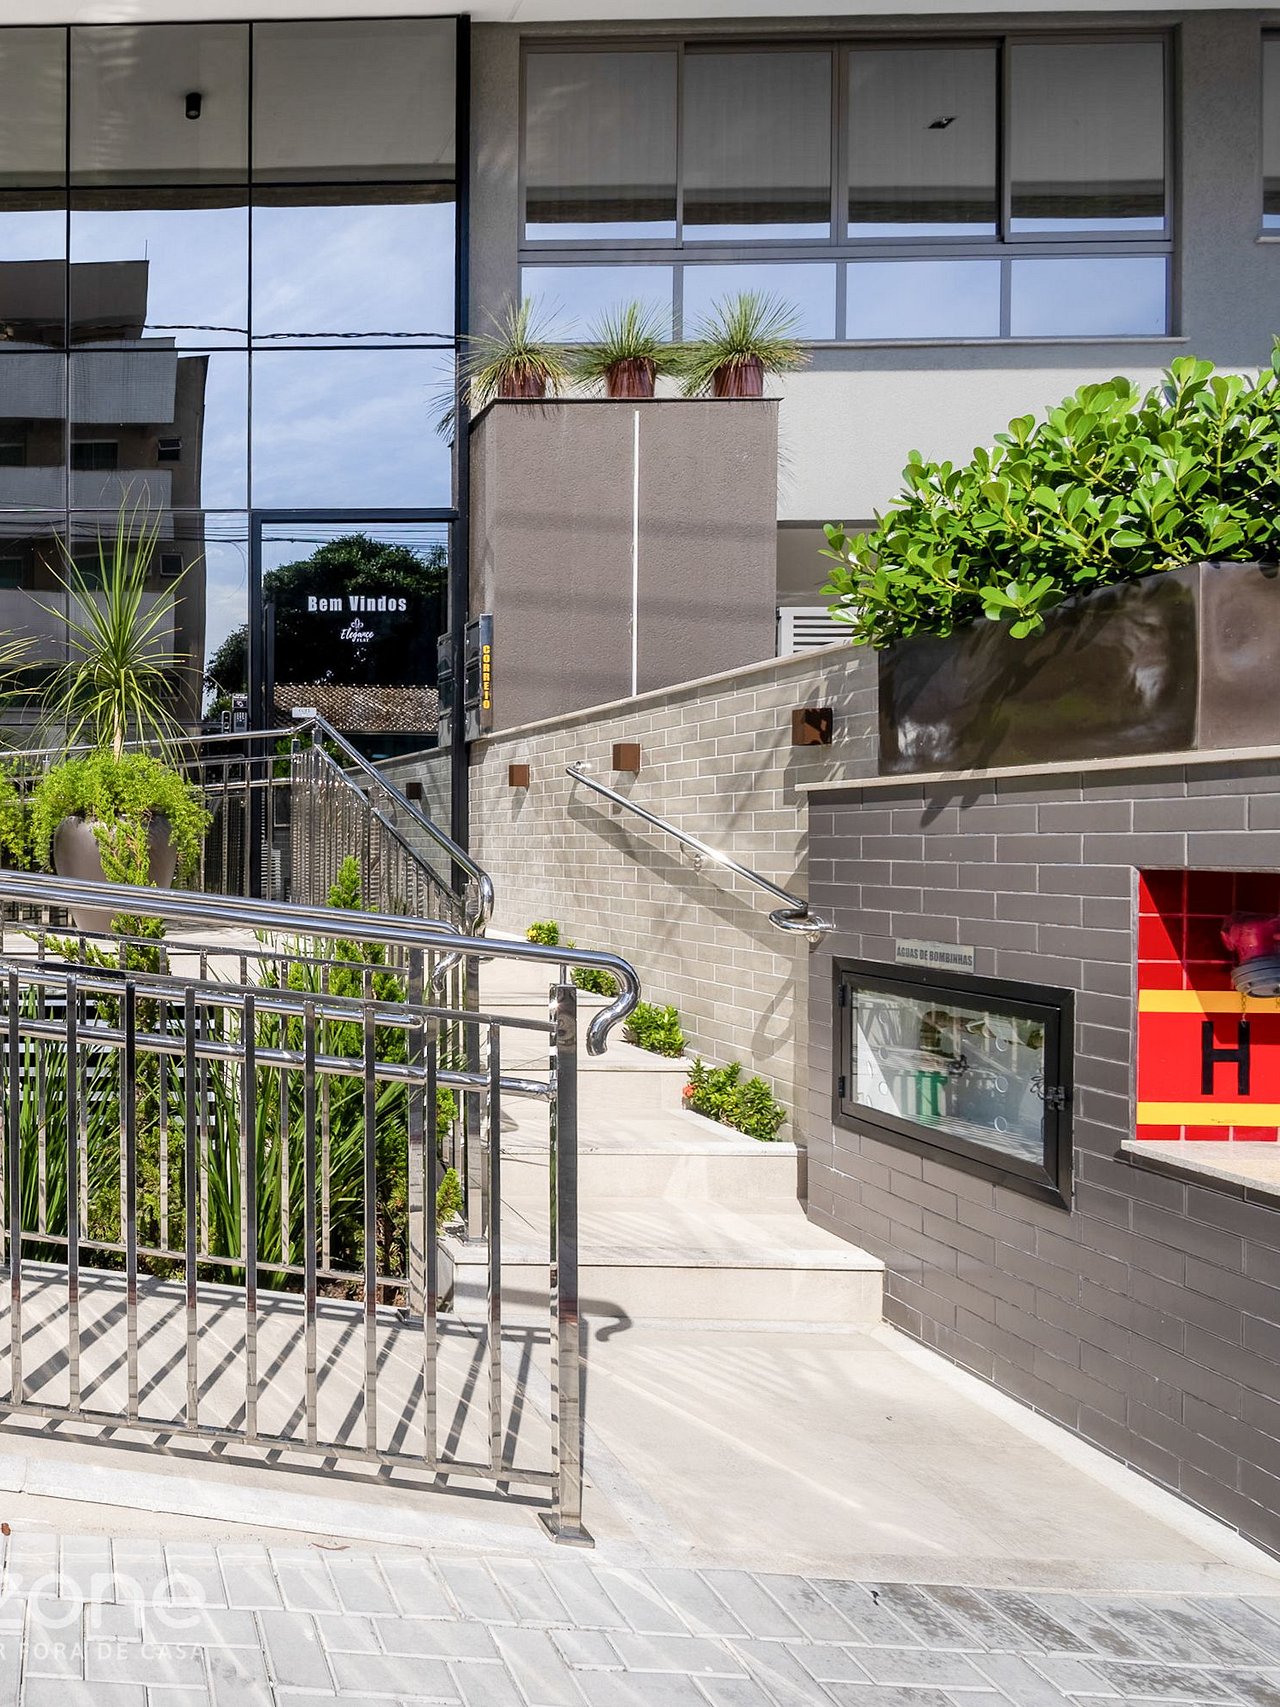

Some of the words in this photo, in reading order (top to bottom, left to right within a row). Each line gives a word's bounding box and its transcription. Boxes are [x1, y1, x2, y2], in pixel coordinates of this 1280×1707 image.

[307, 596, 343, 612] Bem
[349, 595, 407, 612] Vindos
[340, 627, 375, 643] Elegance
[482, 644, 491, 710] CORREIO
[919, 949, 928, 960] DE
[928, 950, 973, 966] BOMBINHAS
[1201, 1020, 1250, 1096] H
